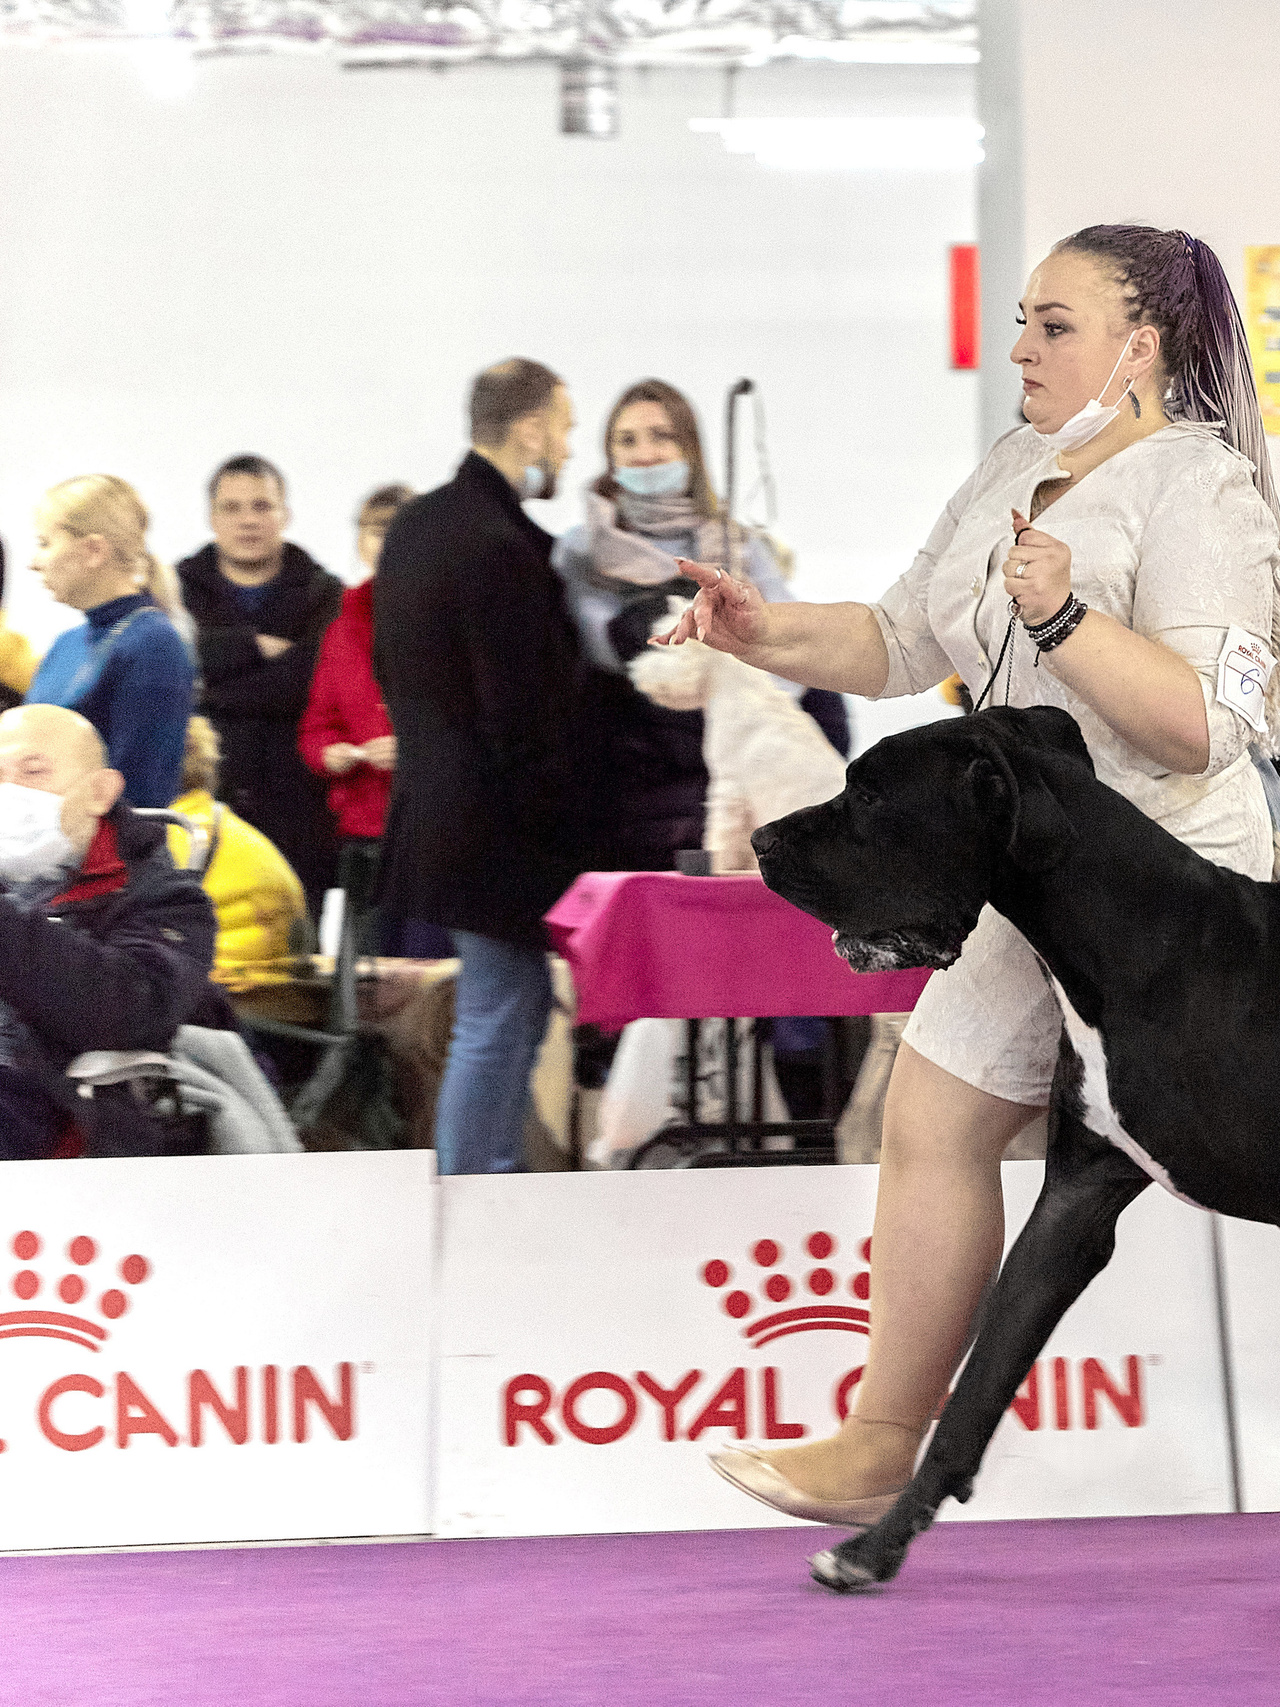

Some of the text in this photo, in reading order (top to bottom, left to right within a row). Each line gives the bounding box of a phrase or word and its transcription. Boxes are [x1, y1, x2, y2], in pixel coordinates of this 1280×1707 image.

[1241, 668, 1260, 695] 6
[35, 1362, 359, 1452] CANIN
[501, 1365, 811, 1447] ROYAL
